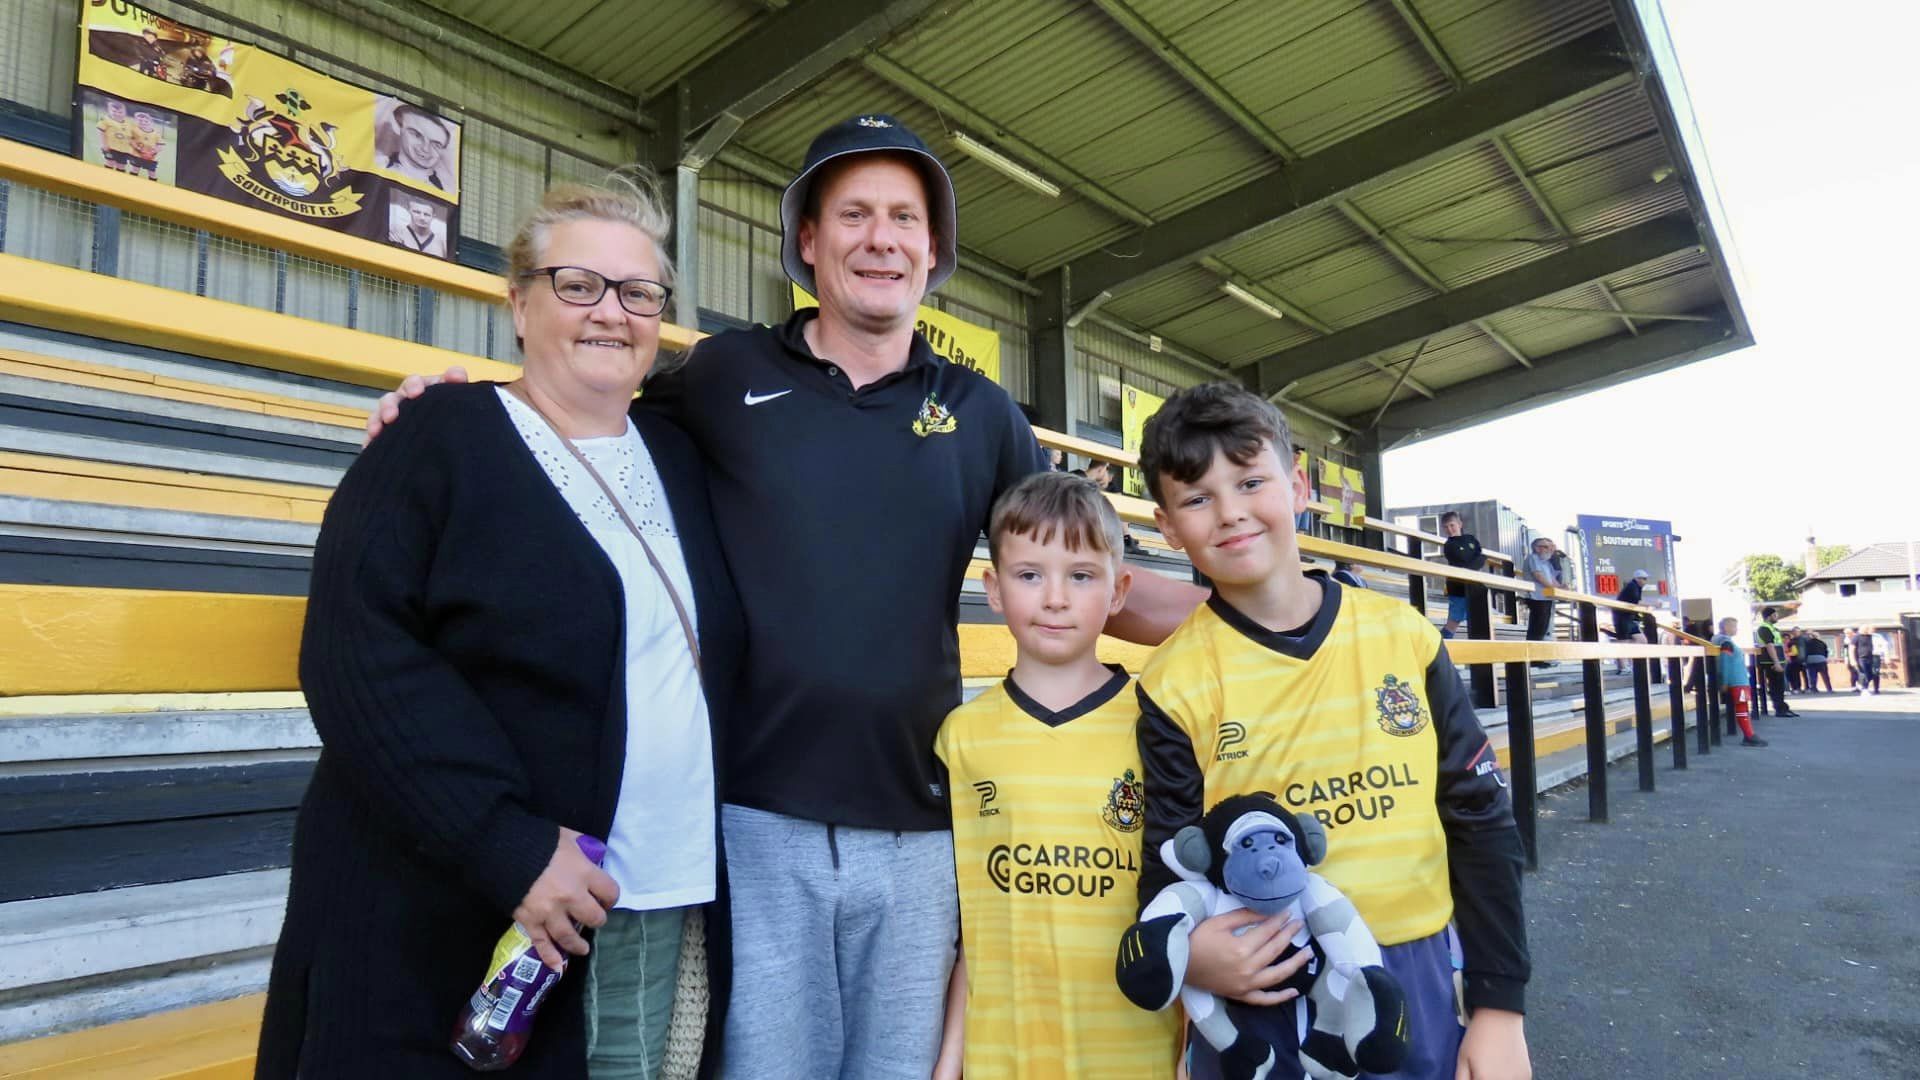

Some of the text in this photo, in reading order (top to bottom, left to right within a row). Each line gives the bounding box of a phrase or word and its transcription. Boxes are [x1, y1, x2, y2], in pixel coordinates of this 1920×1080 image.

[232, 174, 317, 215] SOUTHPORT
[916, 320, 946, 349] arr
[1602, 535, 1653, 547] SOUTHPORT FC
[1216, 750, 1249, 762] ATRICK
[1285, 763, 1419, 807] CARROLL
[1313, 795, 1395, 830] ROUP
[1013, 844, 1137, 872] CARROLL
[1014, 872, 1115, 898] GROUP
